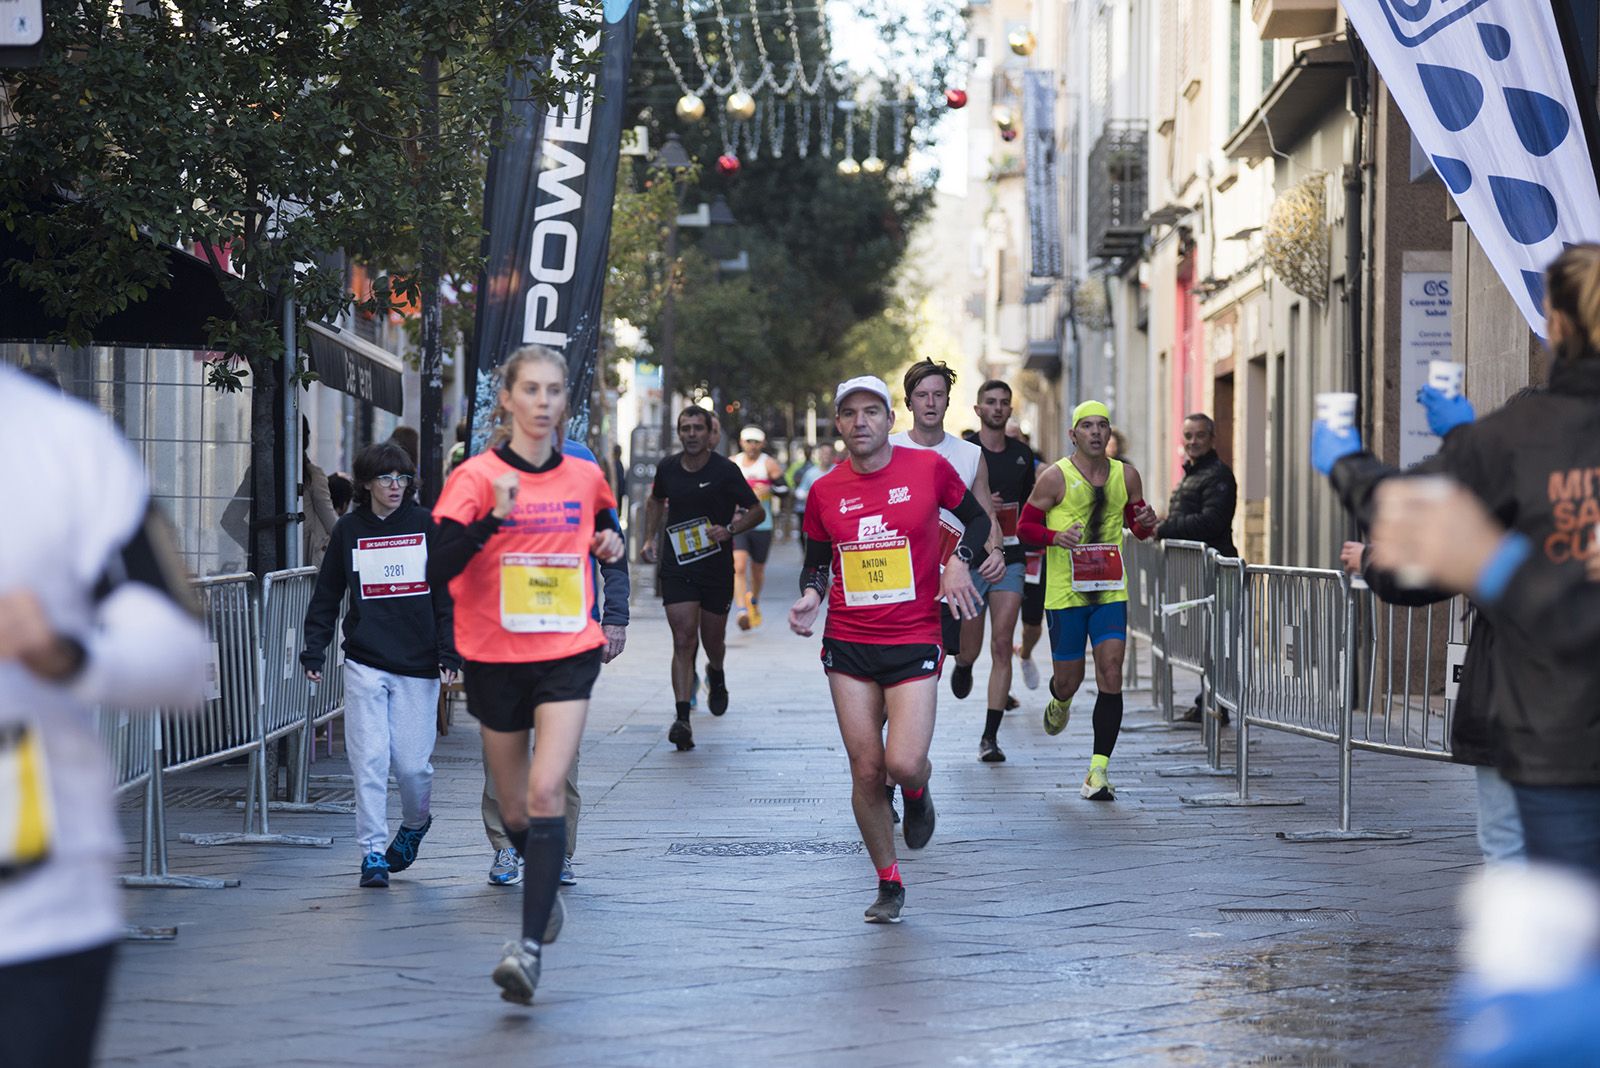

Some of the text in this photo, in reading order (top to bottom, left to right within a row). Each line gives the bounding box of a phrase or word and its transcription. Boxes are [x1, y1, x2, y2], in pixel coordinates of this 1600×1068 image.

[863, 522, 888, 537] 21K
[861, 557, 888, 569] ANTONI
[384, 564, 405, 577] 3281
[868, 570, 884, 583] 149
